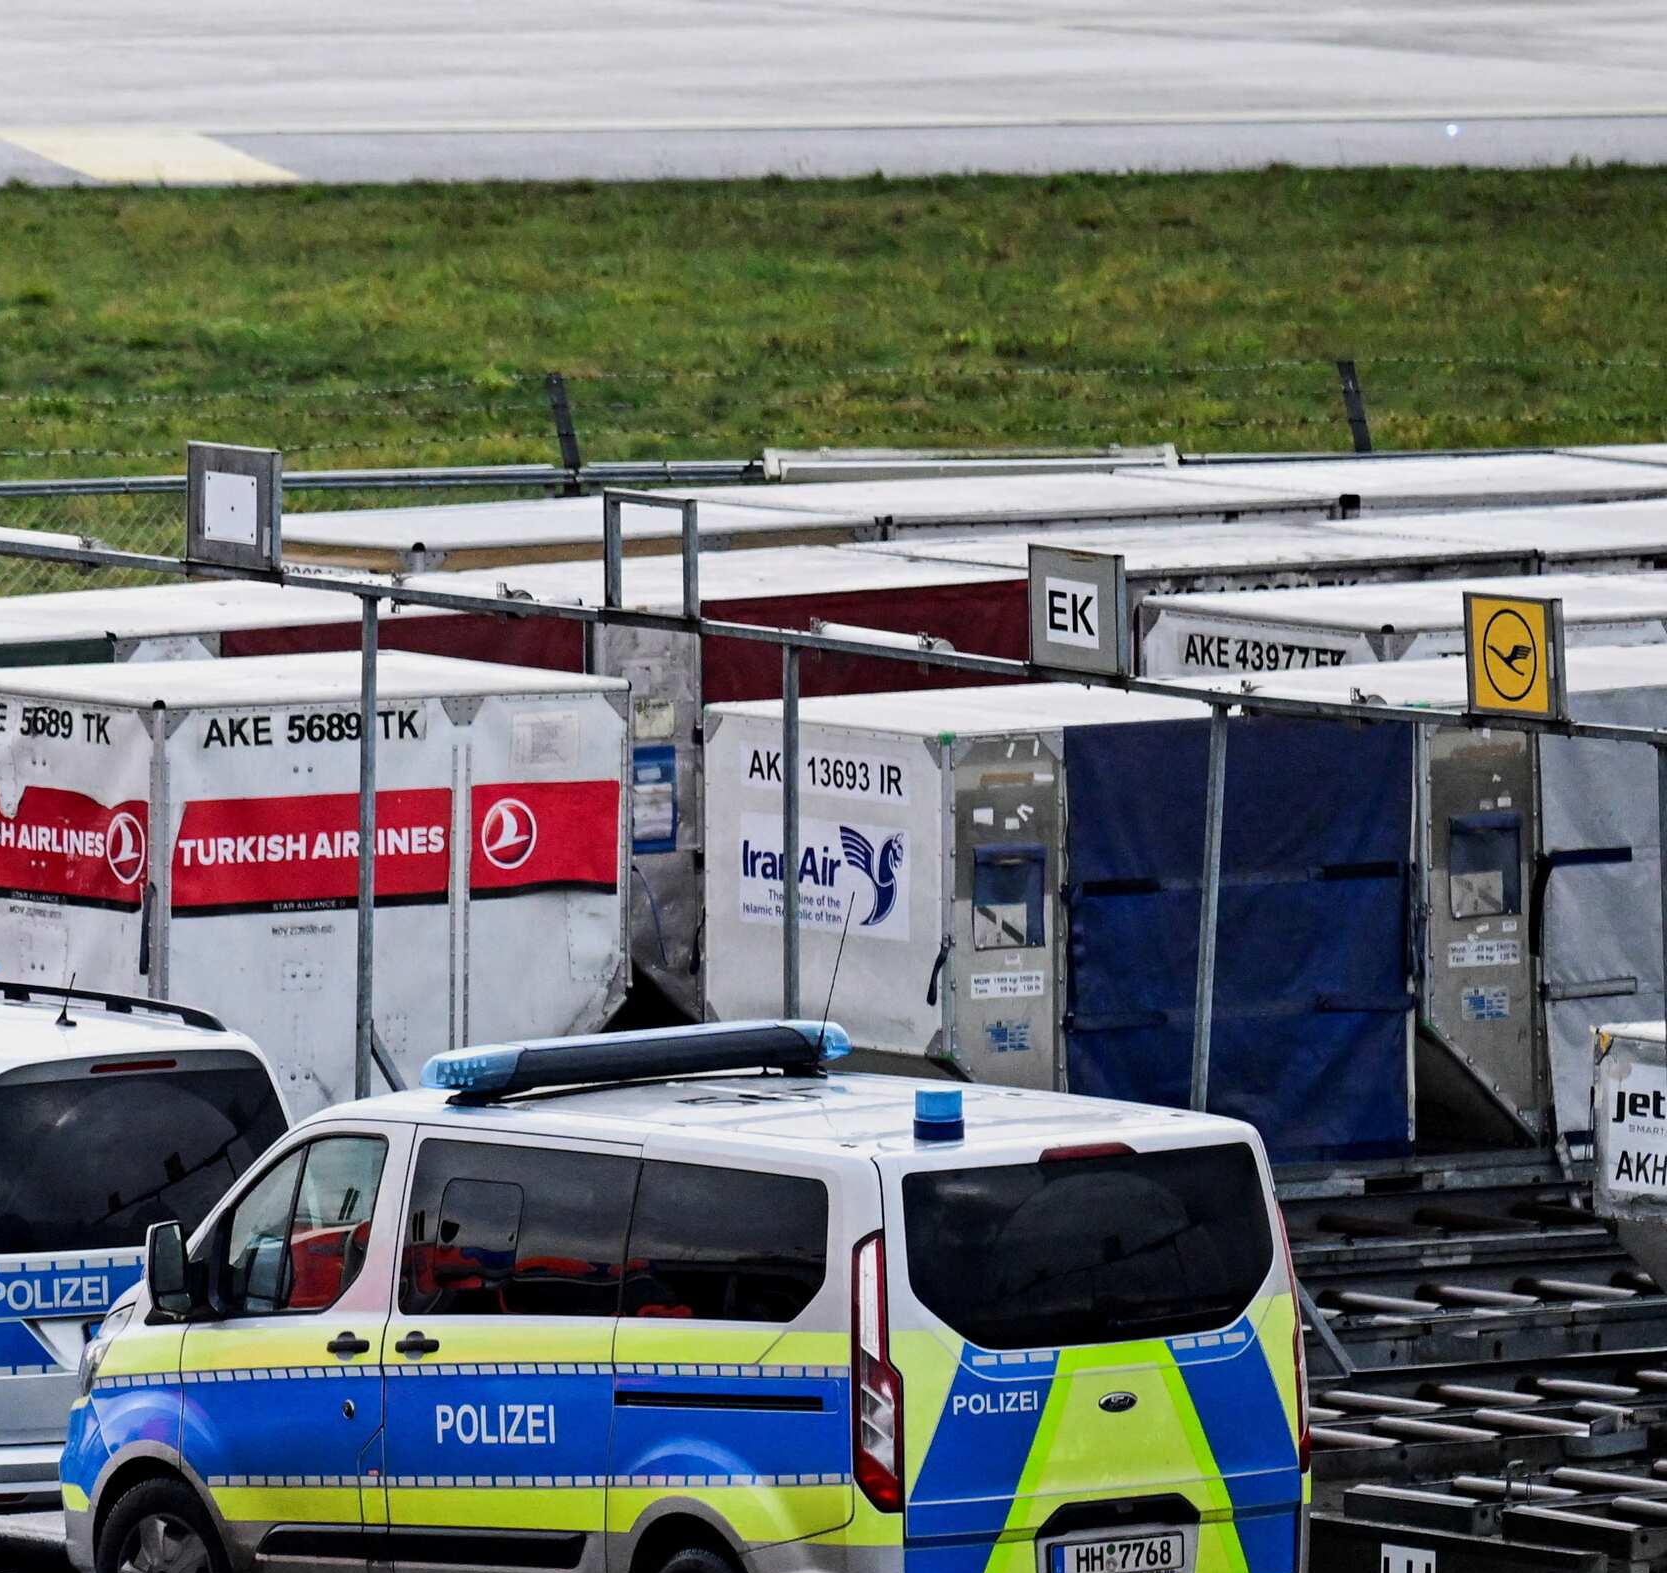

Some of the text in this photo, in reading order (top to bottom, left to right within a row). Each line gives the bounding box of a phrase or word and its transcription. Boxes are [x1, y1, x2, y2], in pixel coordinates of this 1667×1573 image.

[1049, 590, 1095, 636] EK
[1185, 634, 1230, 668] AKE
[1235, 639, 1310, 671] 43977
[20, 706, 73, 739] 5689
[83, 713, 110, 745] TK
[203, 710, 419, 749] AKE 5689 TK
[749, 750, 903, 796] AK 13693 IR
[17, 824, 105, 858] AIRLINES
[178, 826, 445, 867] TURKISH AIRINES
[273, 899, 336, 911] STAR ALLIANCE
[742, 903, 772, 916] Islamic
[825, 913, 842, 924] Iran
[816, 895, 826, 906] of
[827, 895, 841, 909] the
[1612, 1090, 1666, 1123] jet
[1615, 1150, 1667, 1187] AKH
[953, 1390, 1038, 1416] POLIZEI
[436, 1404, 555, 1444] POLIZEI
[1076, 1539, 1172, 1573] HH 7768
